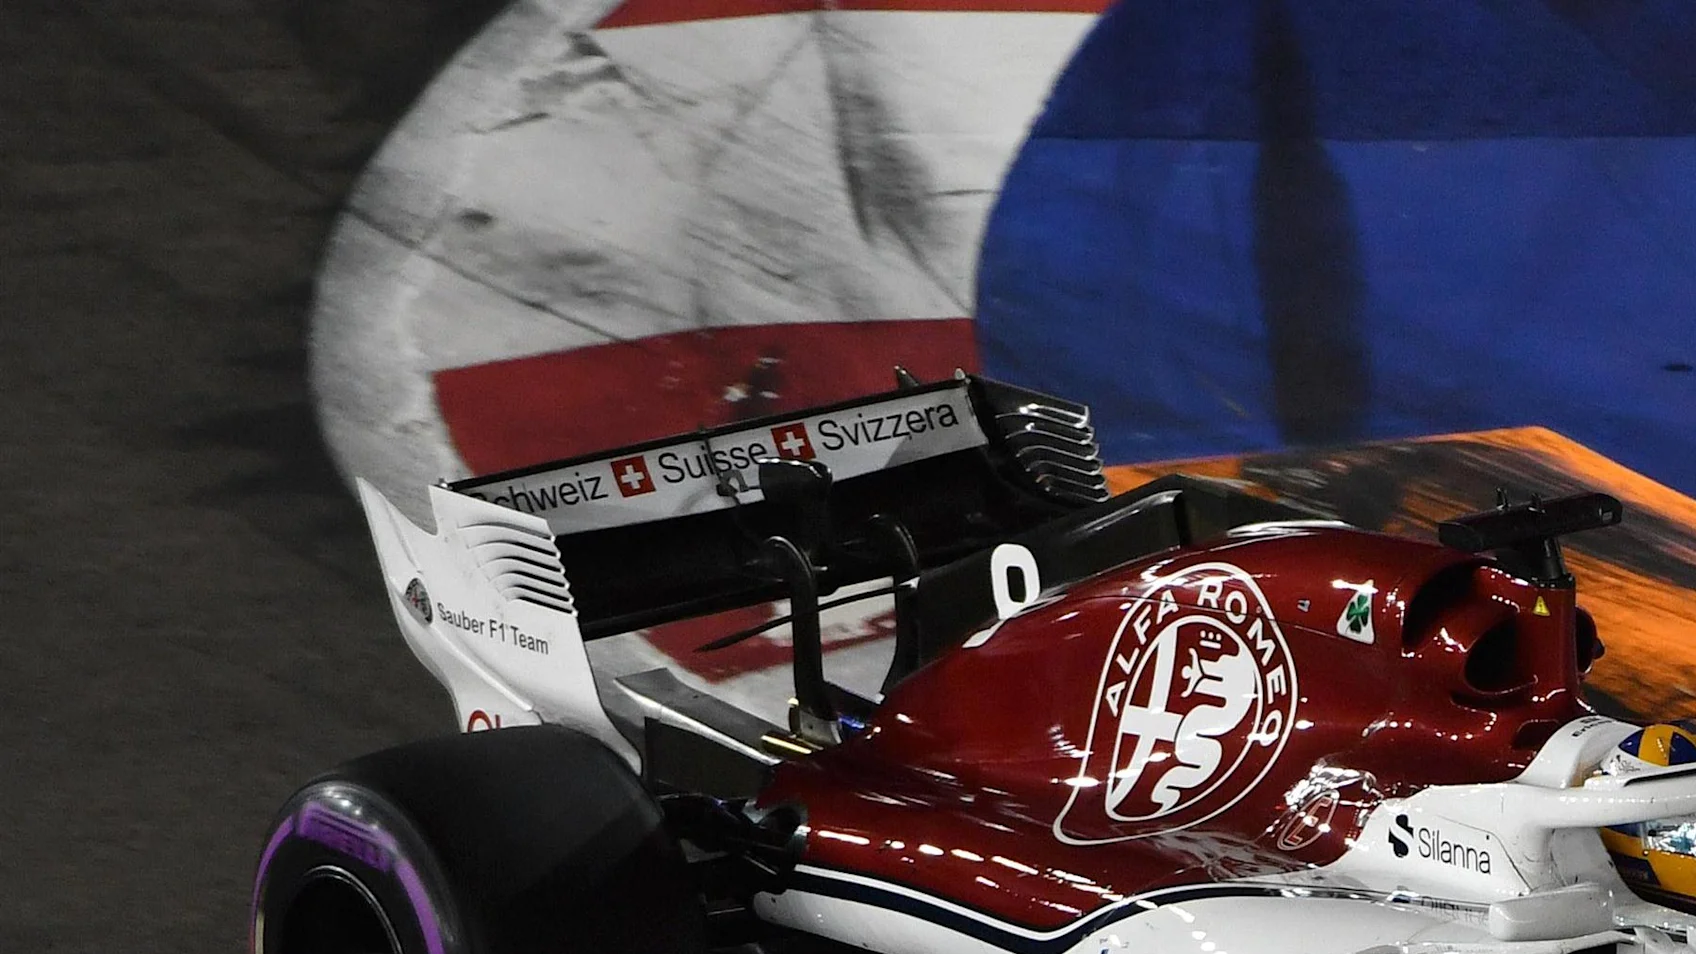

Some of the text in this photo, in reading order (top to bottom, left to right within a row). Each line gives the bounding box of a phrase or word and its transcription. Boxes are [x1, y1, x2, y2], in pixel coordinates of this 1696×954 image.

[469, 403, 959, 513] hweiz Suisse Svizzera
[437, 602, 549, 655] Sauber F1 Team
[1105, 583, 1287, 747] ALFA ROMEO
[1418, 827, 1491, 874] Silanna
